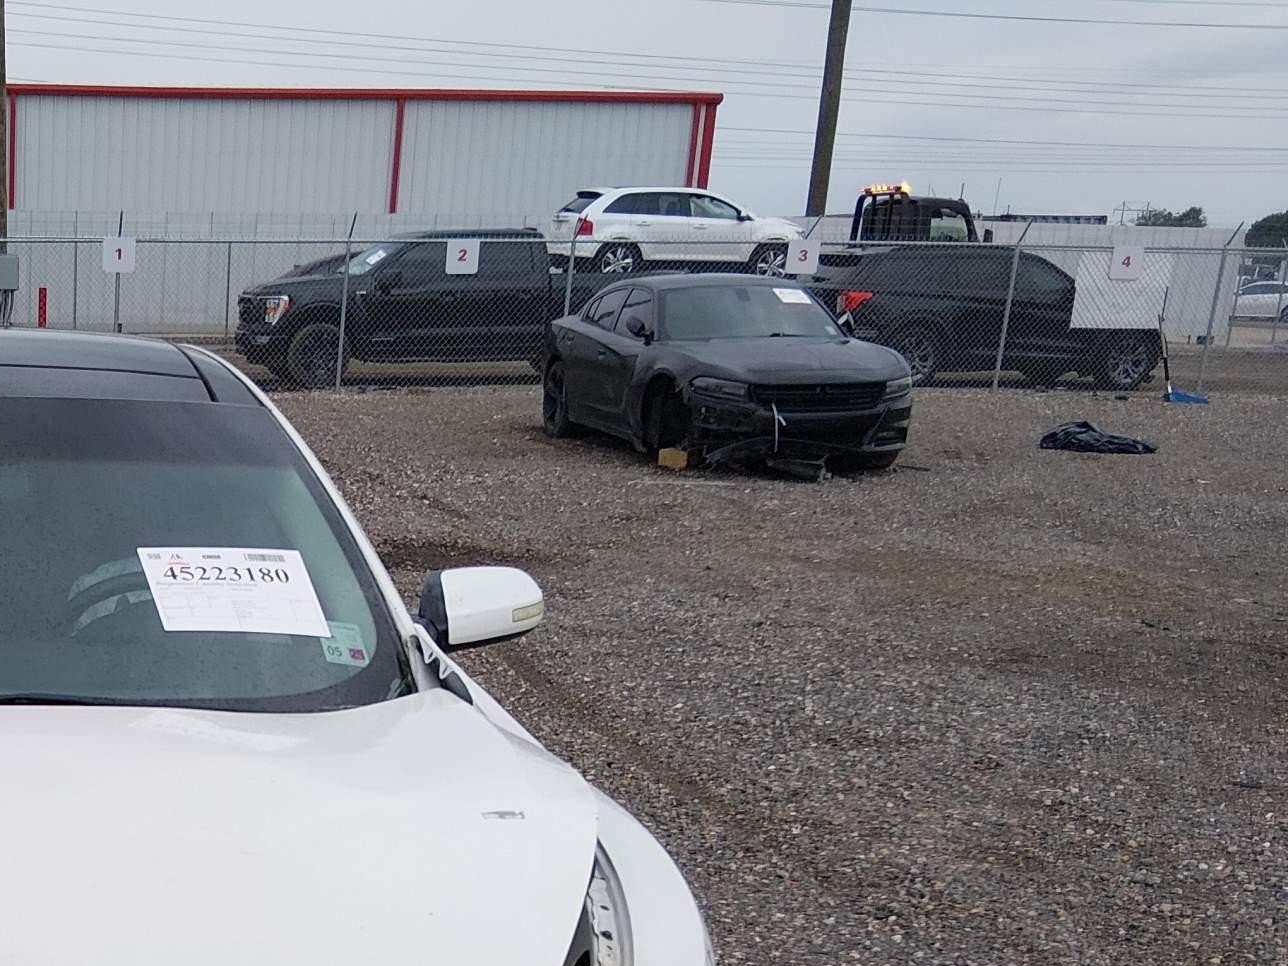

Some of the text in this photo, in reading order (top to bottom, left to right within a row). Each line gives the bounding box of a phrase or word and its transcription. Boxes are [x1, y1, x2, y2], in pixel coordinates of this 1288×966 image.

[115, 248, 122, 260] 1
[457, 248, 468, 262] 2
[798, 249, 809, 262] 3
[1121, 255, 1131, 268] 4
[163, 565, 290, 584] 45223180
[327, 645, 343, 657] 05
